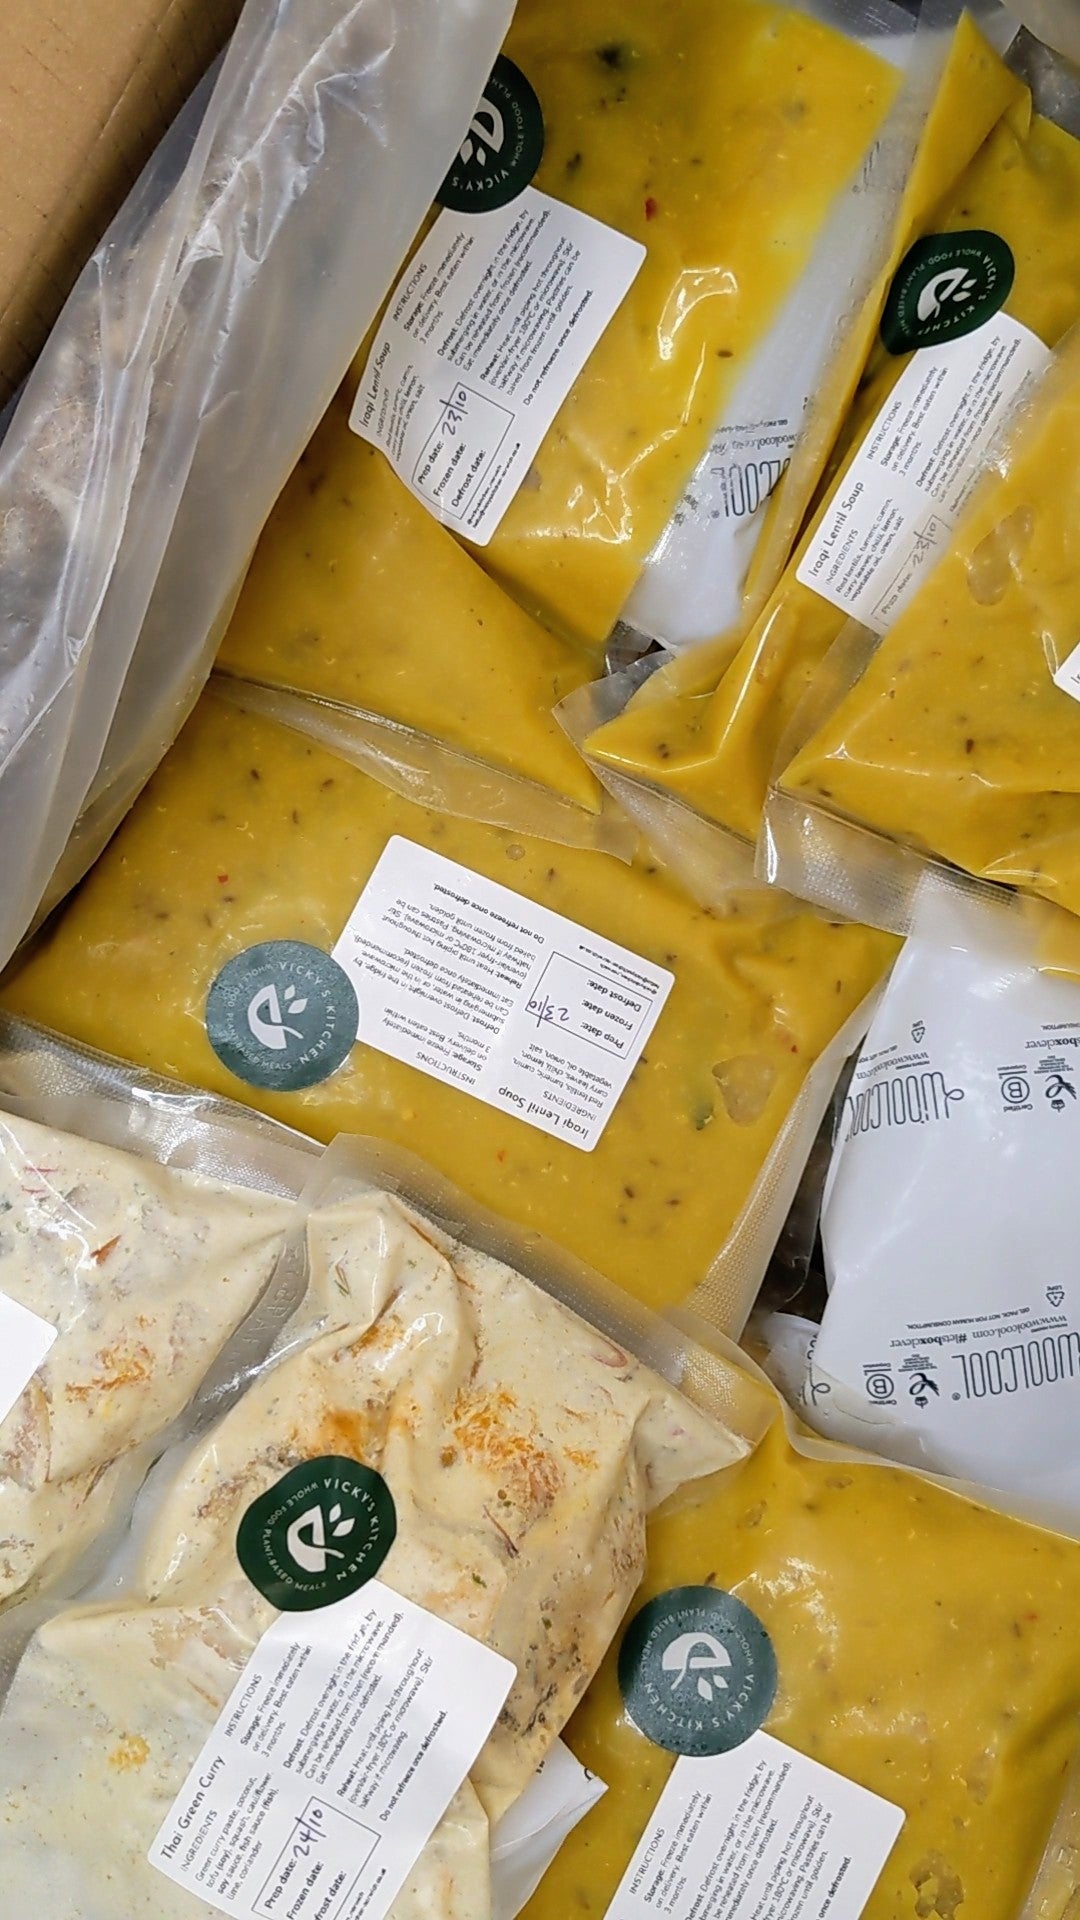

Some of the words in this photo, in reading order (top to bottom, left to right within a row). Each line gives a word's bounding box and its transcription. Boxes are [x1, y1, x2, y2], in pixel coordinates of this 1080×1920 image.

[452, 169, 509, 191] VICKY'S
[359, 400, 375, 427] Iraqi
[375, 342, 391, 369] Soup
[865, 401, 902, 459] INSTRUCTIONS
[417, 464, 431, 484] Prep
[428, 440, 444, 463] date:
[432, 466, 454, 496] Frozen
[450, 442, 466, 466] date:
[451, 472, 474, 507] Defrost
[470, 449, 486, 472] date:
[807, 549, 830, 576] Iraqi
[822, 511, 847, 546] Lentil
[841, 481, 863, 511] Soup
[825, 528, 858, 585] INGREDIENTS
[433, 883, 470, 905] defrosted.
[470, 902, 488, 914] once
[489, 911, 519, 929] refreeze
[519, 926, 532, 936] not
[533, 933, 544, 944] Do
[586, 979, 608, 994] date:
[608, 990, 641, 1012] Defrost
[581, 999, 603, 1014] date:
[604, 1010, 633, 1030] Frozen
[299, 1004, 336, 1064] KITCHEN
[580, 1021, 606, 1037] date:
[604, 1033, 624, 1049] Prep
[415, 1051, 476, 1085] INSTRUCTIONS
[498, 1086, 526, 1108] Soup
[526, 1101, 560, 1125] Lentil
[542, 1090, 596, 1121] INGREDIENTS
[1003, 1103, 1034, 1113] Certified
[561, 1117, 588, 1139] Iraqi
[889, 1332, 967, 1348] #letsboxclever
[288, 1482, 319, 1507] WHOLE
[324, 1478, 376, 1512] VICKY'S
[267, 1506, 288, 1525] FOOD
[336, 1515, 379, 1580] KITCHEN
[223, 1673, 262, 1737] INSTRUCTIONS
[644, 1682, 703, 1730] KITCHEN
[711, 1674, 755, 1728] VICKY'S
[160, 1830, 183, 1859] Thai
[177, 1791, 205, 1829] Green
[198, 1755, 225, 1788] Curry
[180, 1809, 217, 1871] INGREDIENTS
[293, 1809, 327, 1858] 24/10
[659, 1840, 678, 1867] Freeze
[674, 1790, 702, 1840] immediately
[628, 1827, 664, 1894] INSTRUCTIONS
[655, 1896, 664, 1908] on
[674, 1843, 689, 1862] Best
[686, 1819, 700, 1842] eaten
[697, 1793, 711, 1818] within
[264, 1885, 282, 1909] Prep
[278, 1858, 297, 1884] date:
[285, 1887, 309, 1919] Frozen
[305, 1861, 324, 1886] date:
[818, 1898, 831, 1918] once
[827, 1856, 851, 1897] defrosted.
[663, 1906, 671, 1914] 3
